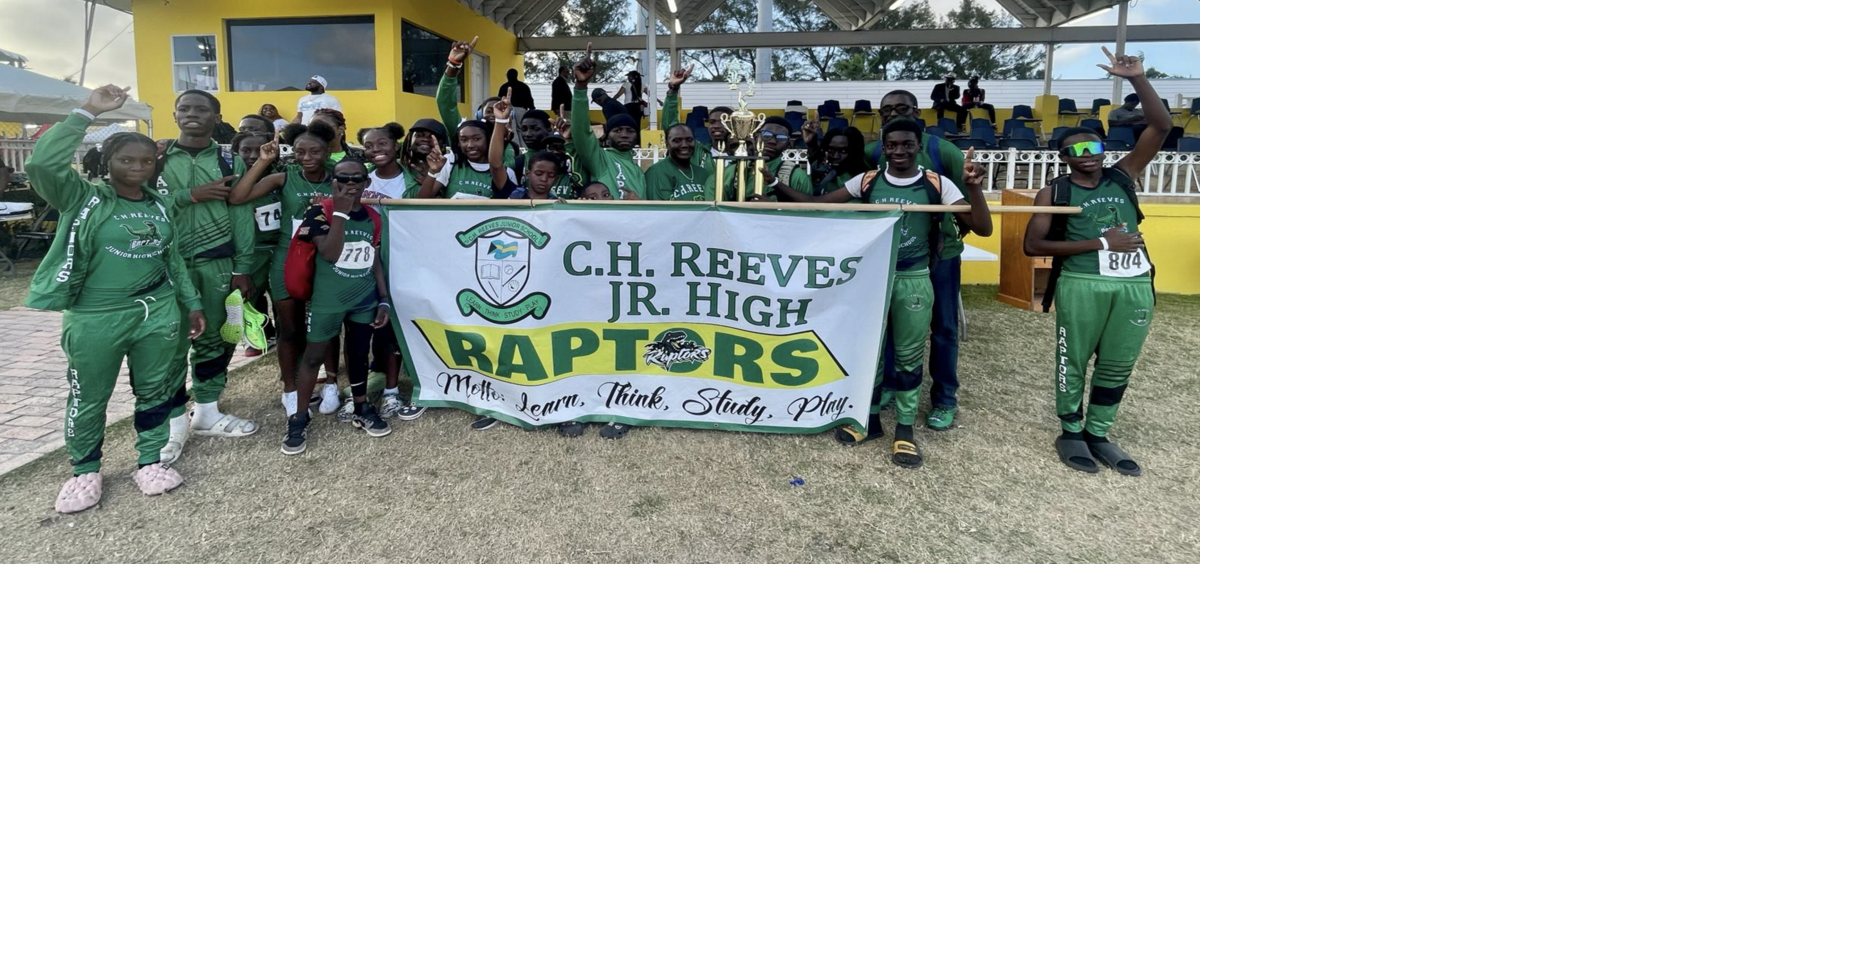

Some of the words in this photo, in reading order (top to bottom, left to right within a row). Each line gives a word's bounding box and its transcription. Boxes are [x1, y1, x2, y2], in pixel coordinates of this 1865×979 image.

[343, 245, 370, 263] 778
[520, 225, 539, 243] SCHOOL
[562, 241, 655, 277] C.H.
[670, 241, 863, 289] REEVES
[1108, 251, 1142, 271] 804
[465, 295, 482, 311] LEARN
[484, 307, 501, 317] THINK
[503, 308, 523, 319] STUDY
[525, 297, 539, 310] PLAY
[607, 281, 670, 323] JR.
[686, 281, 813, 328] HIGH
[444, 327, 820, 387] RAPTORS
[1058, 326, 1068, 392] RAPTORS
[436, 372, 506, 402] Motto:
[515, 392, 585, 421] Learn,
[597, 380, 670, 412] Think,
[682, 387, 773, 425] Study,
[787, 391, 854, 421] Play.
